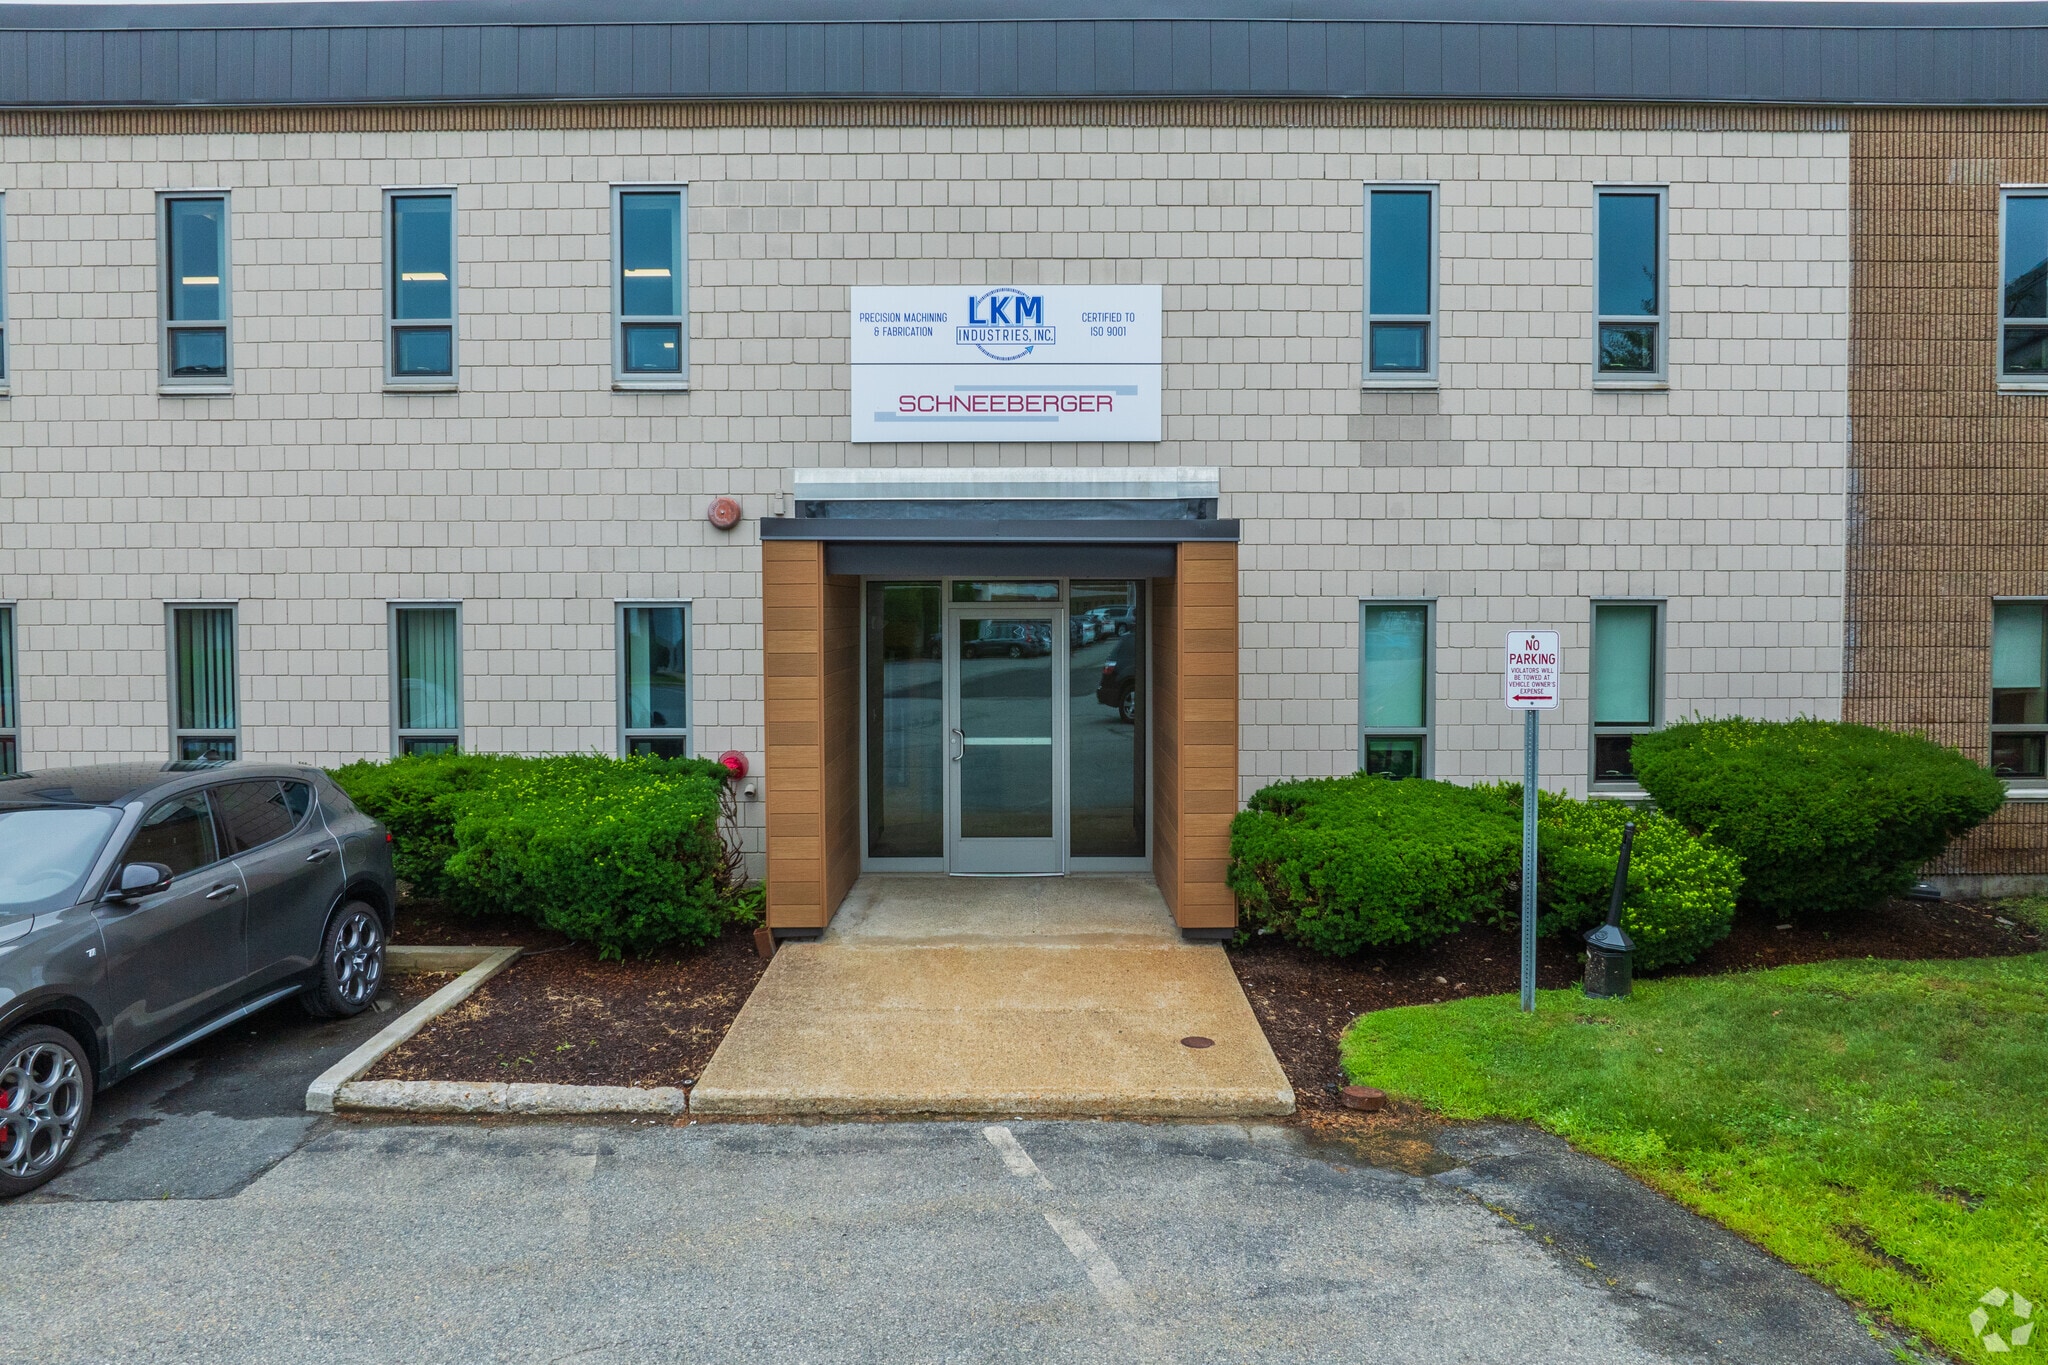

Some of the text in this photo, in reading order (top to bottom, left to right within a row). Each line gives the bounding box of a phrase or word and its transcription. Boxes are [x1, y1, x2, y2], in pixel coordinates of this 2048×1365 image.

[969, 296, 1043, 326] LKM
[859, 313, 947, 323] PRECISION MACHINING
[1081, 312, 1135, 323] CERTIFIED TO
[874, 327, 933, 336] & FABRICATION
[958, 329, 1053, 342] INDUSTRIES, INC.
[1090, 327, 1126, 336] ISO 9001
[899, 395, 1113, 412] SCHNEEBERGER
[1525, 640, 1540, 651] NO
[1509, 654, 1556, 664] PARKING
